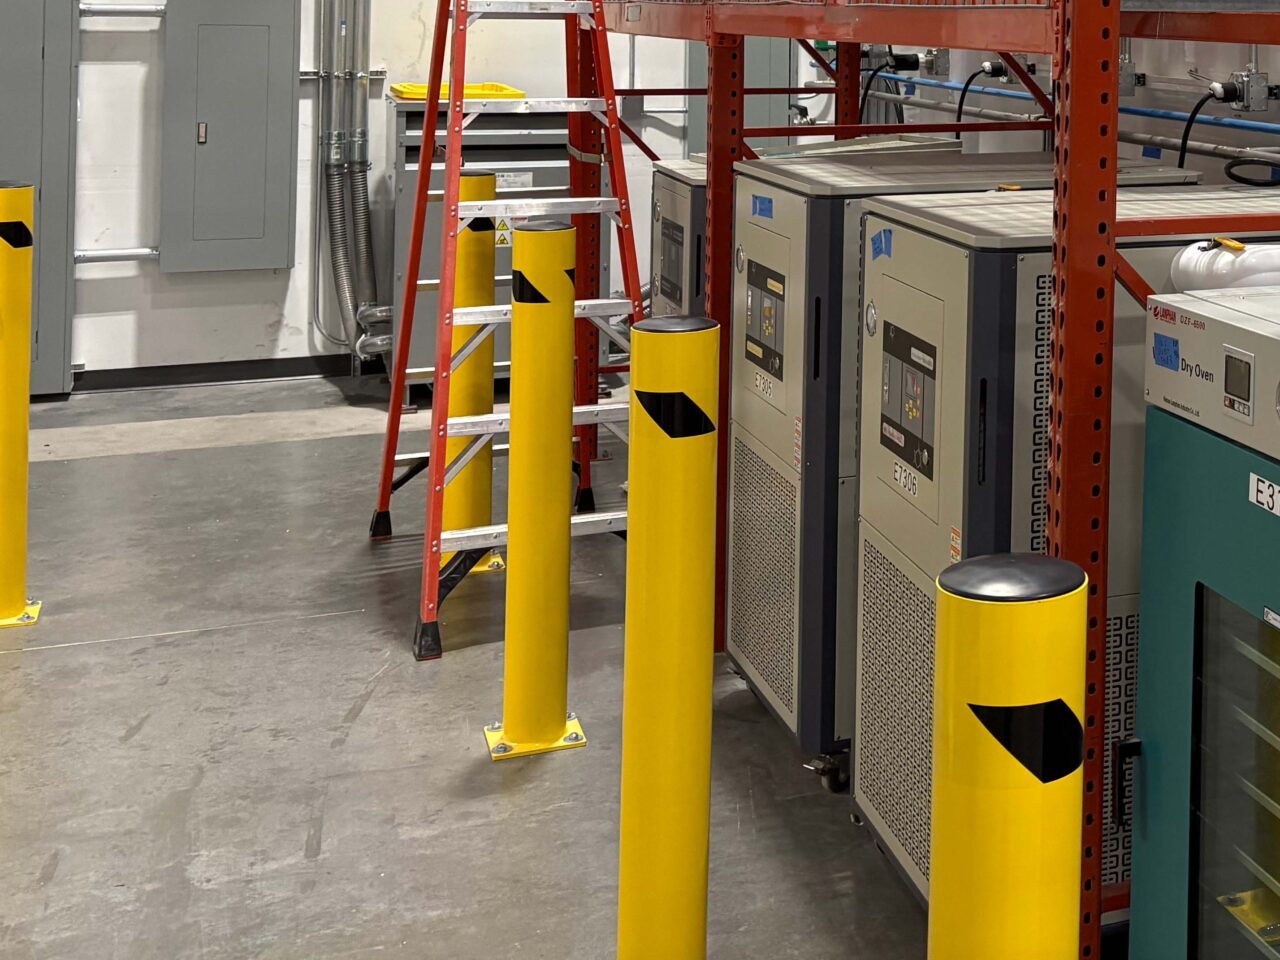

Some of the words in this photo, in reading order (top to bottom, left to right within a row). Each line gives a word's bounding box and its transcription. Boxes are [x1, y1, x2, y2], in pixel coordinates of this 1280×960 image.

[1181, 358, 1194, 378] Dry
[1195, 364, 1214, 383] Oven
[755, 372, 773, 398] E7305
[894, 462, 917, 496] E7306
